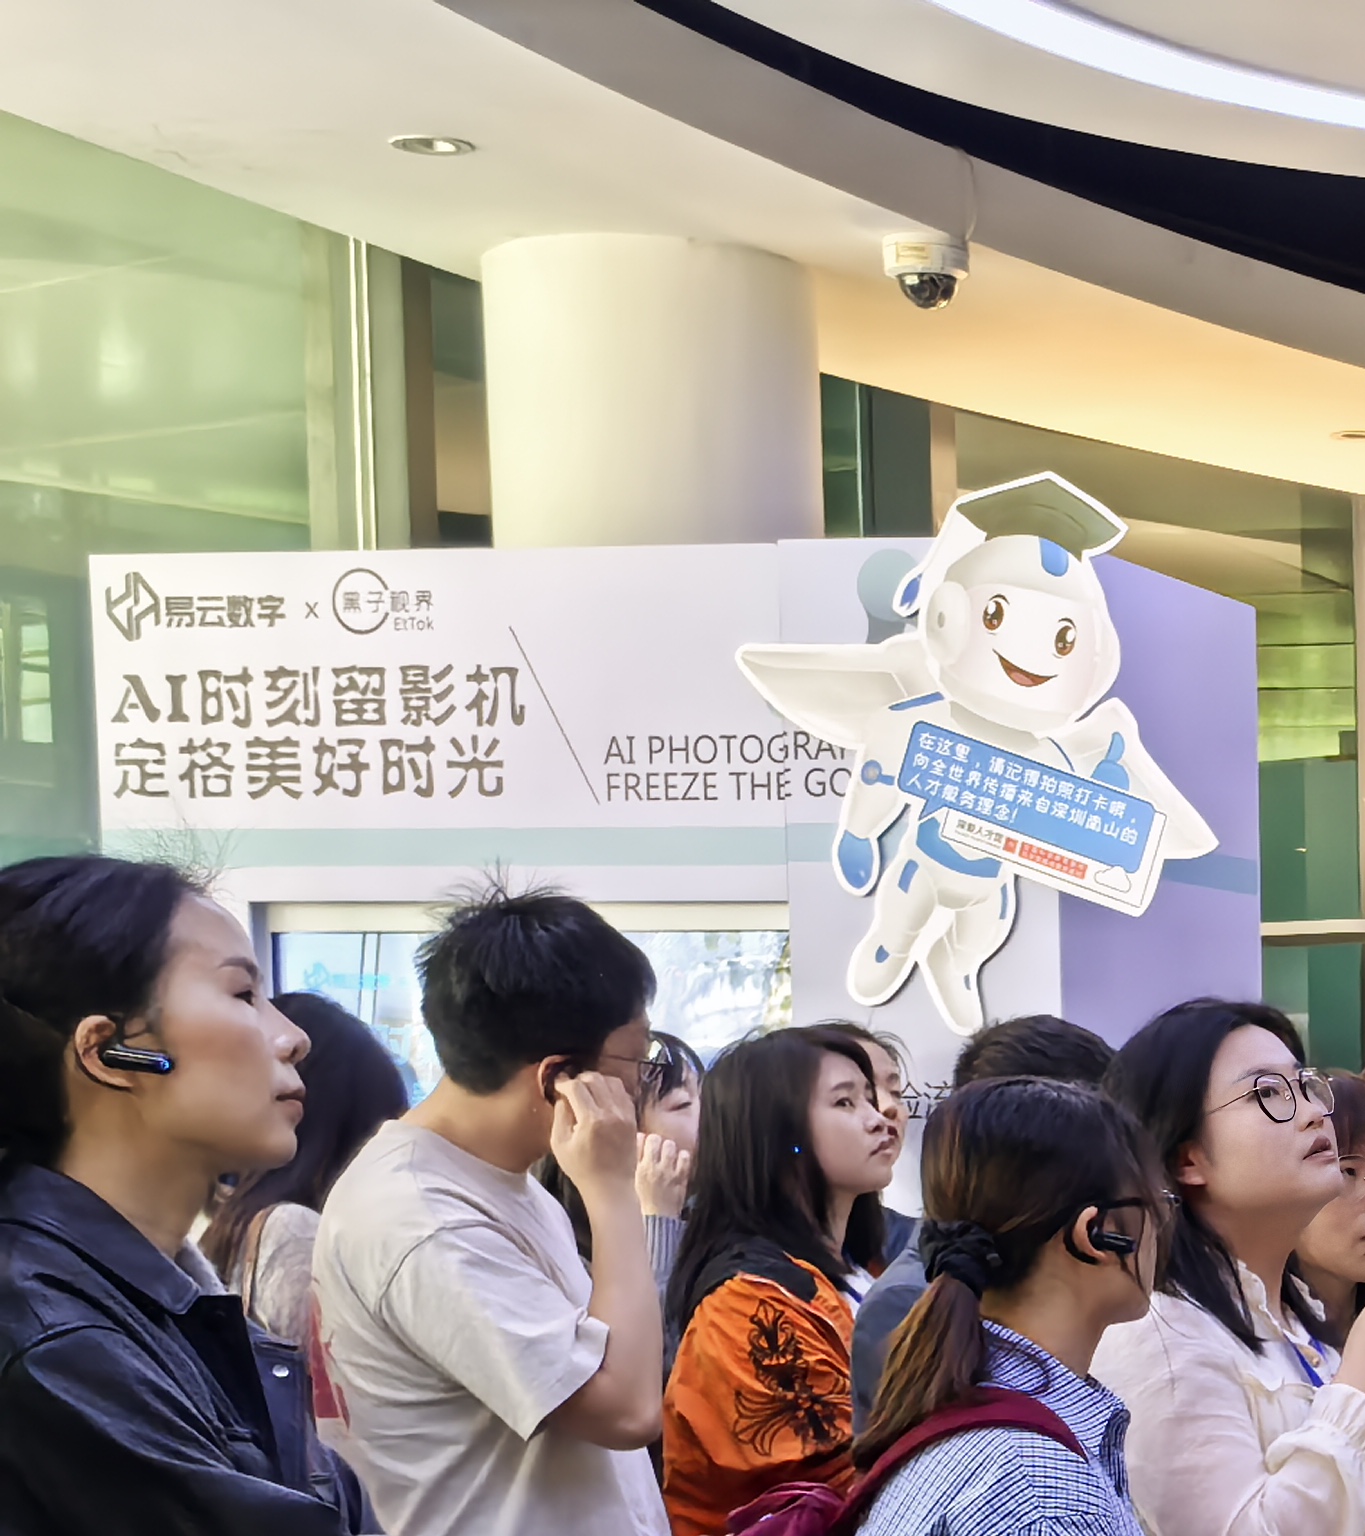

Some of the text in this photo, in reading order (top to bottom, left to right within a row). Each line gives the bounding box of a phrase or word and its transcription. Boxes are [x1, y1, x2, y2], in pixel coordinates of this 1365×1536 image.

[164, 595, 287, 628] 易云数字
[110, 663, 526, 729] AI时刻留影机
[603, 731, 846, 765] AI PHOTOGRA
[112, 735, 506, 800] 定格美好时光
[606, 772, 719, 802] FREEZE
[729, 768, 792, 801] THE
